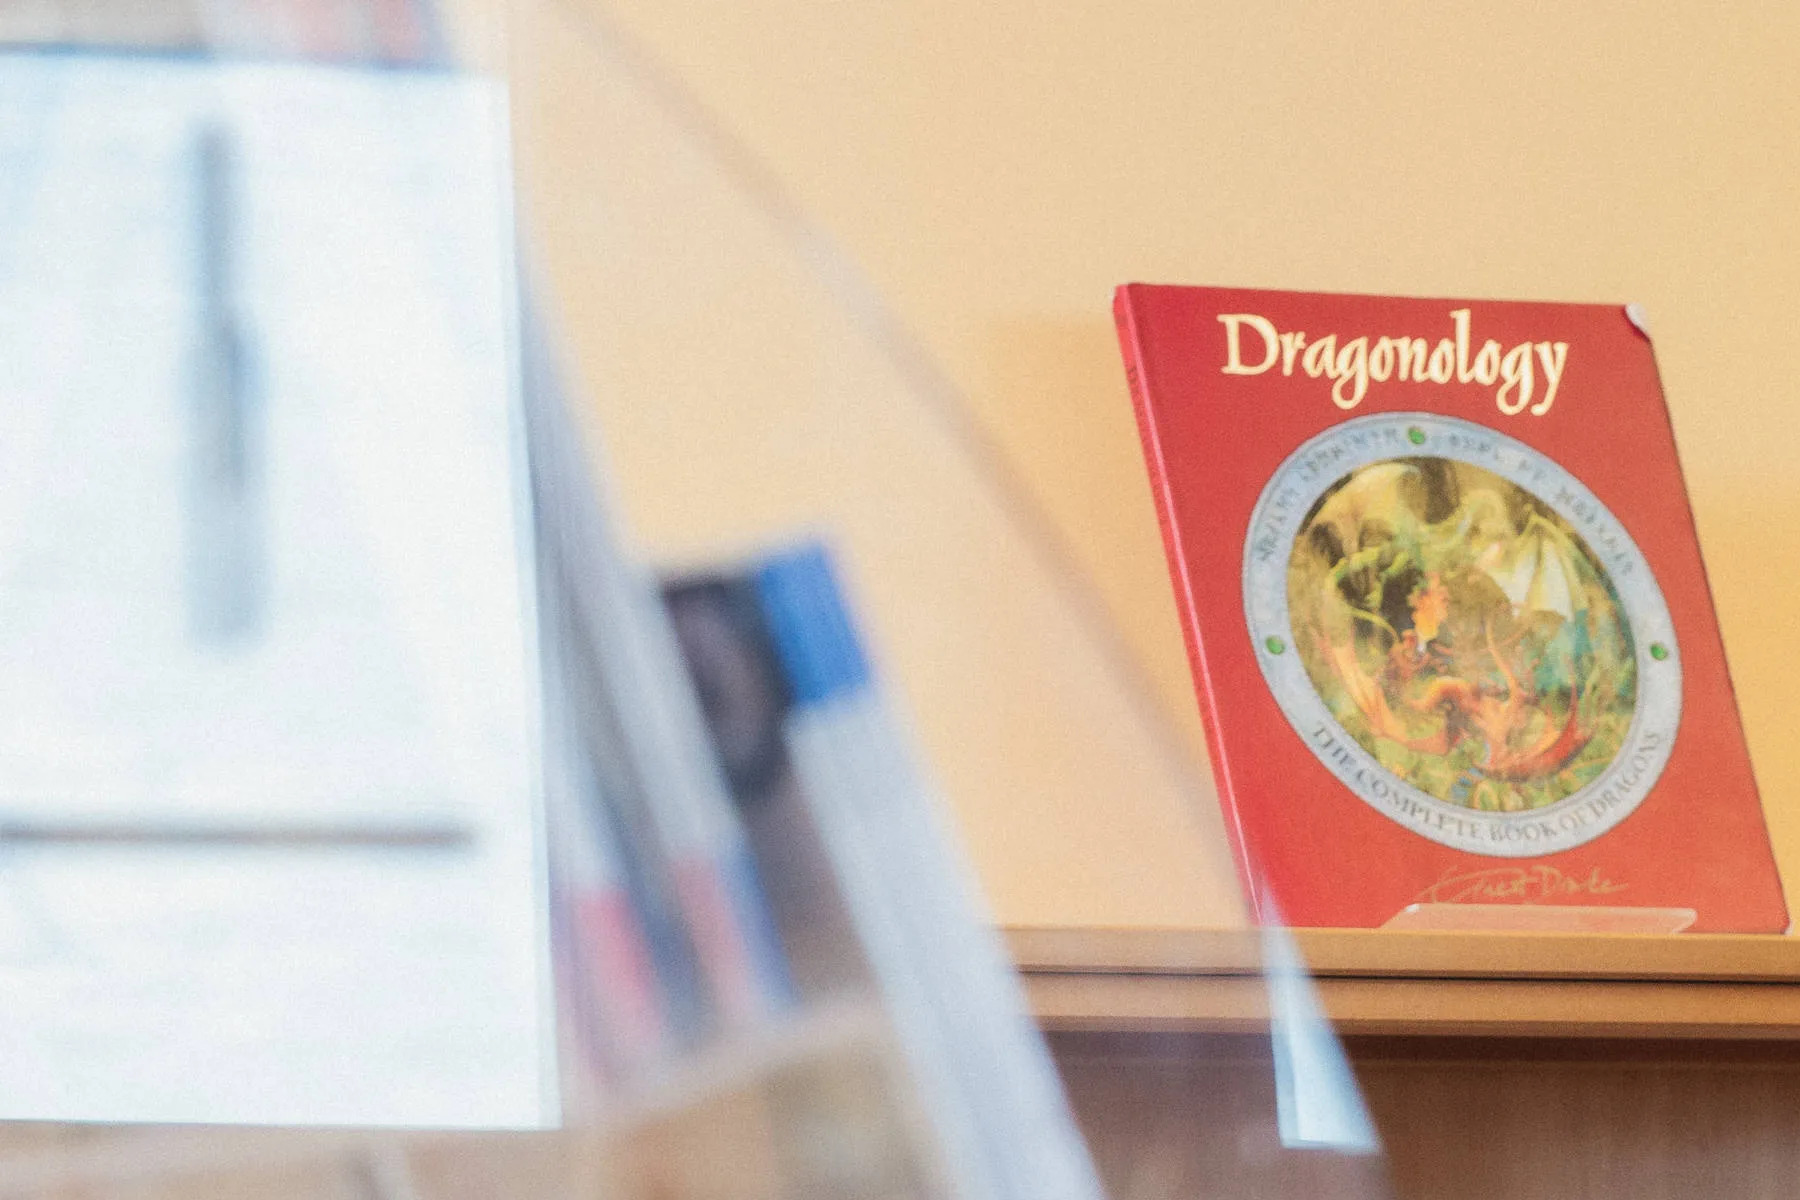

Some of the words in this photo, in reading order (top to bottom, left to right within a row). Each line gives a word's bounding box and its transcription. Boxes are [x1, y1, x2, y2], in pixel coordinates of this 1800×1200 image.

[1217, 307, 1569, 416] Dragonology
[1312, 720, 1352, 765] THE
[1354, 763, 1480, 840] COMPLETE
[1490, 819, 1557, 843] BOOK
[1585, 731, 1662, 821] DRAGONS
